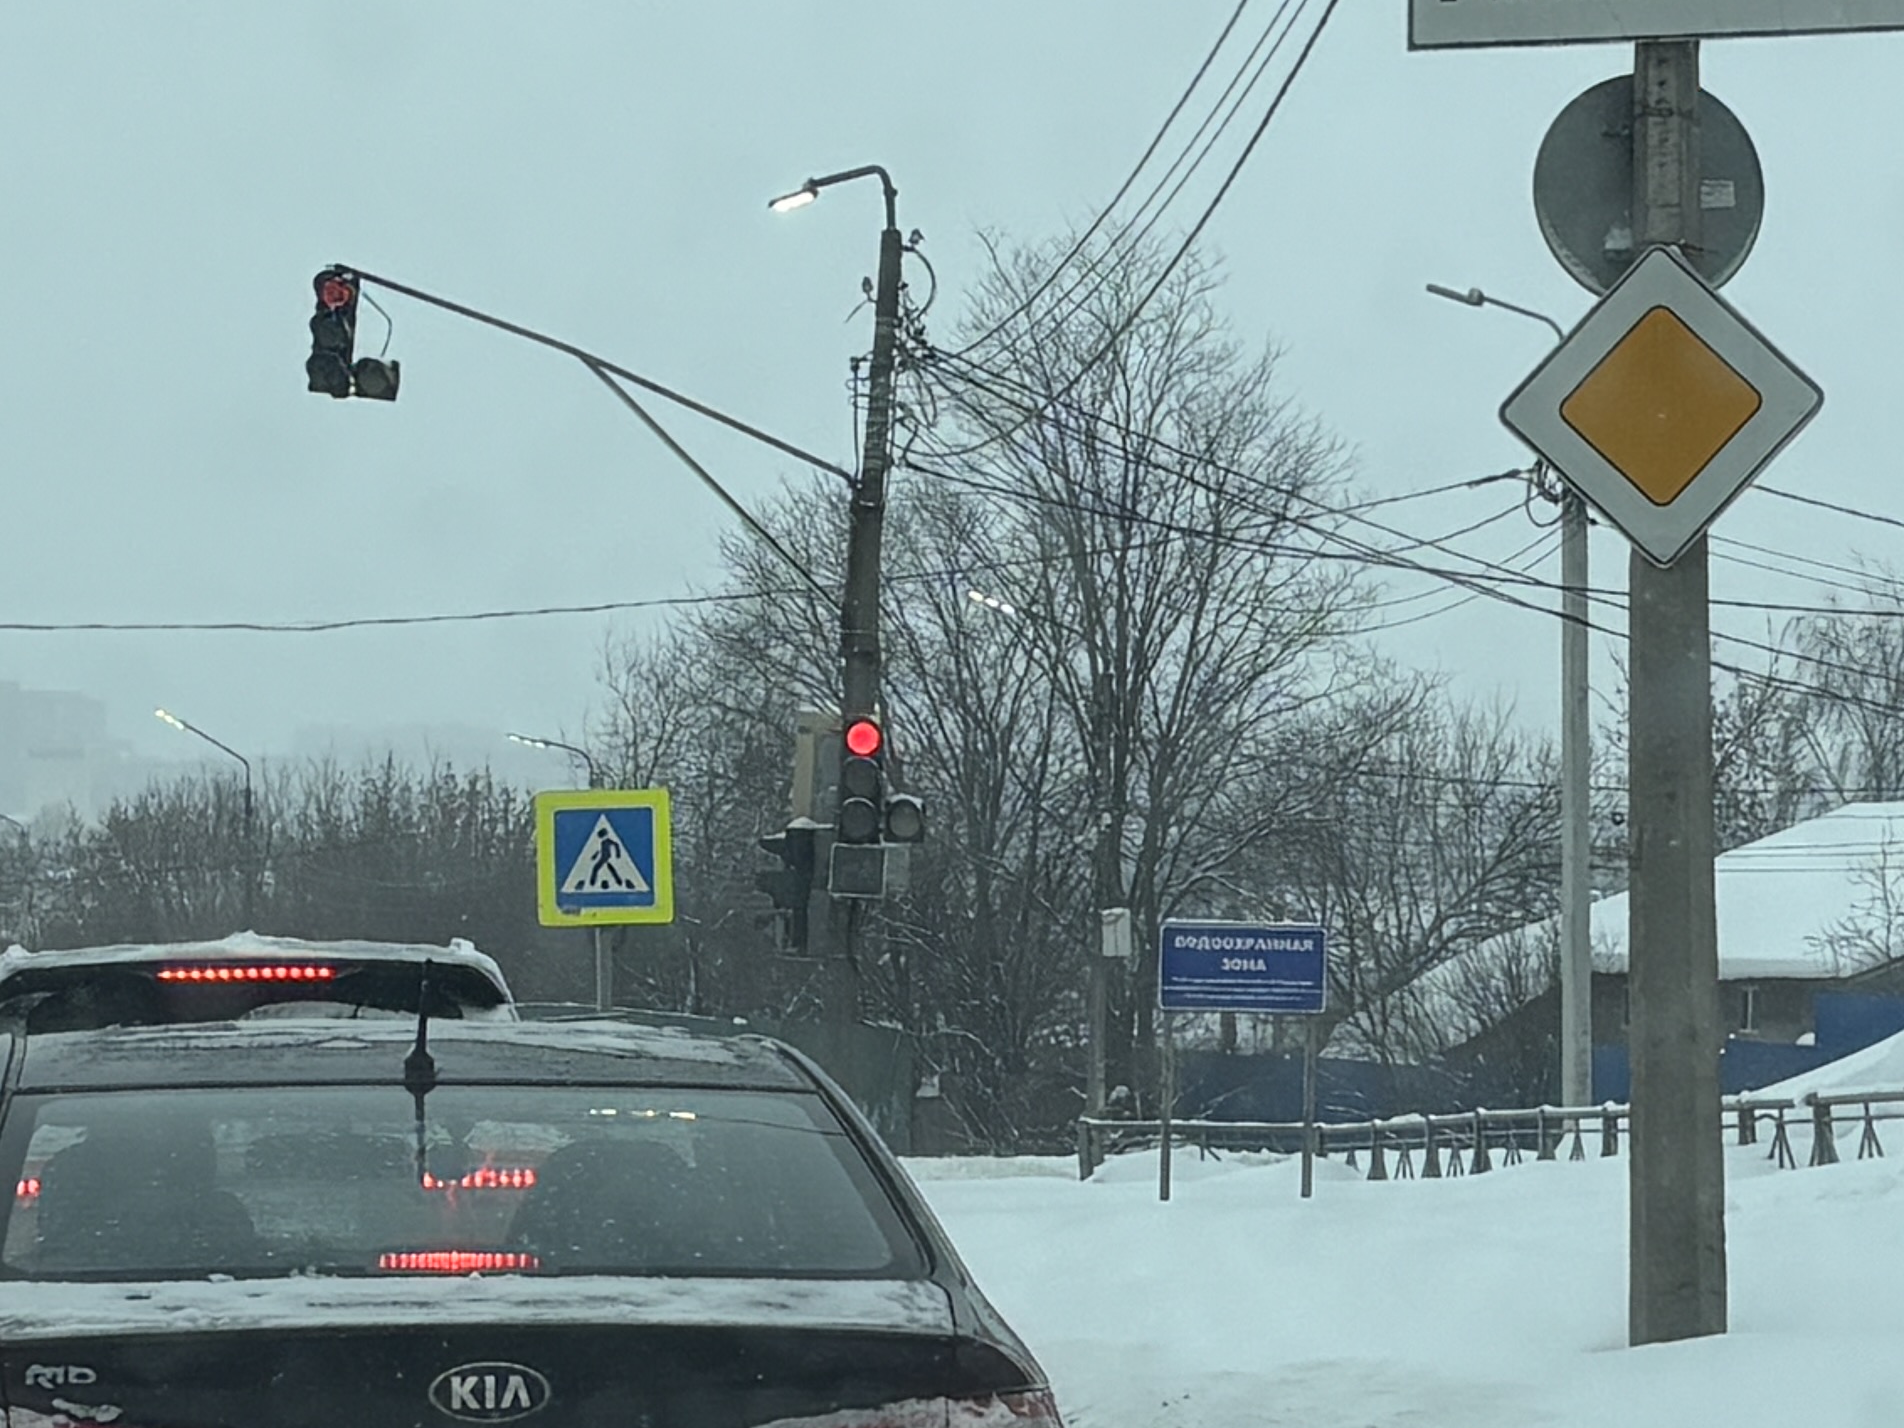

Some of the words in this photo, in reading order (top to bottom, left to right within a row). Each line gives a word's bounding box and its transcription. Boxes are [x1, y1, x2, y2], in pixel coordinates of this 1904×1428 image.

[1174, 935, 1314, 952] ВОДООХРАННАЯ
[1221, 957, 1267, 971] ЗОНА
[449, 1374, 532, 1410] KIA
